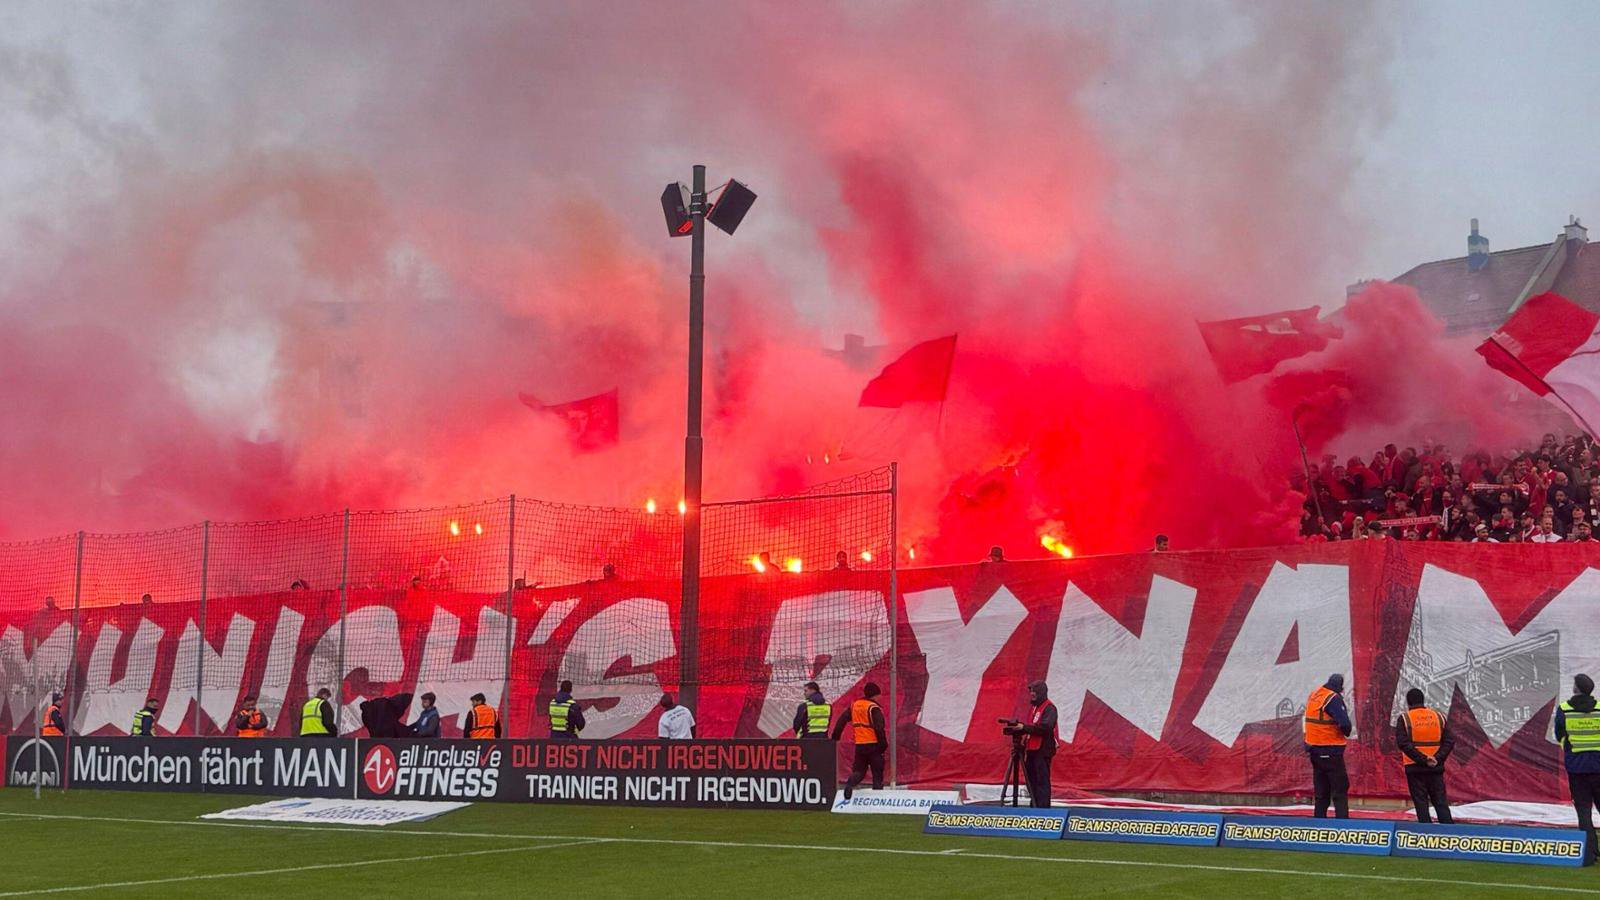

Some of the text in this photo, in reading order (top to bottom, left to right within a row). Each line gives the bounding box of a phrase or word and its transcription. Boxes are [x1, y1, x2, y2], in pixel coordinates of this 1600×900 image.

[73, 745, 347, 787] München fährt MAN
[399, 744, 420, 766] all
[512, 744, 808, 770] DU BIST NICHT IRGENDWER.
[13, 770, 56, 786] MAN
[394, 767, 500, 798] FITNESS
[526, 774, 827, 804] TRAINIER NICHT IRGENDWO.
[852, 797, 917, 808] REGIONALLIGA
